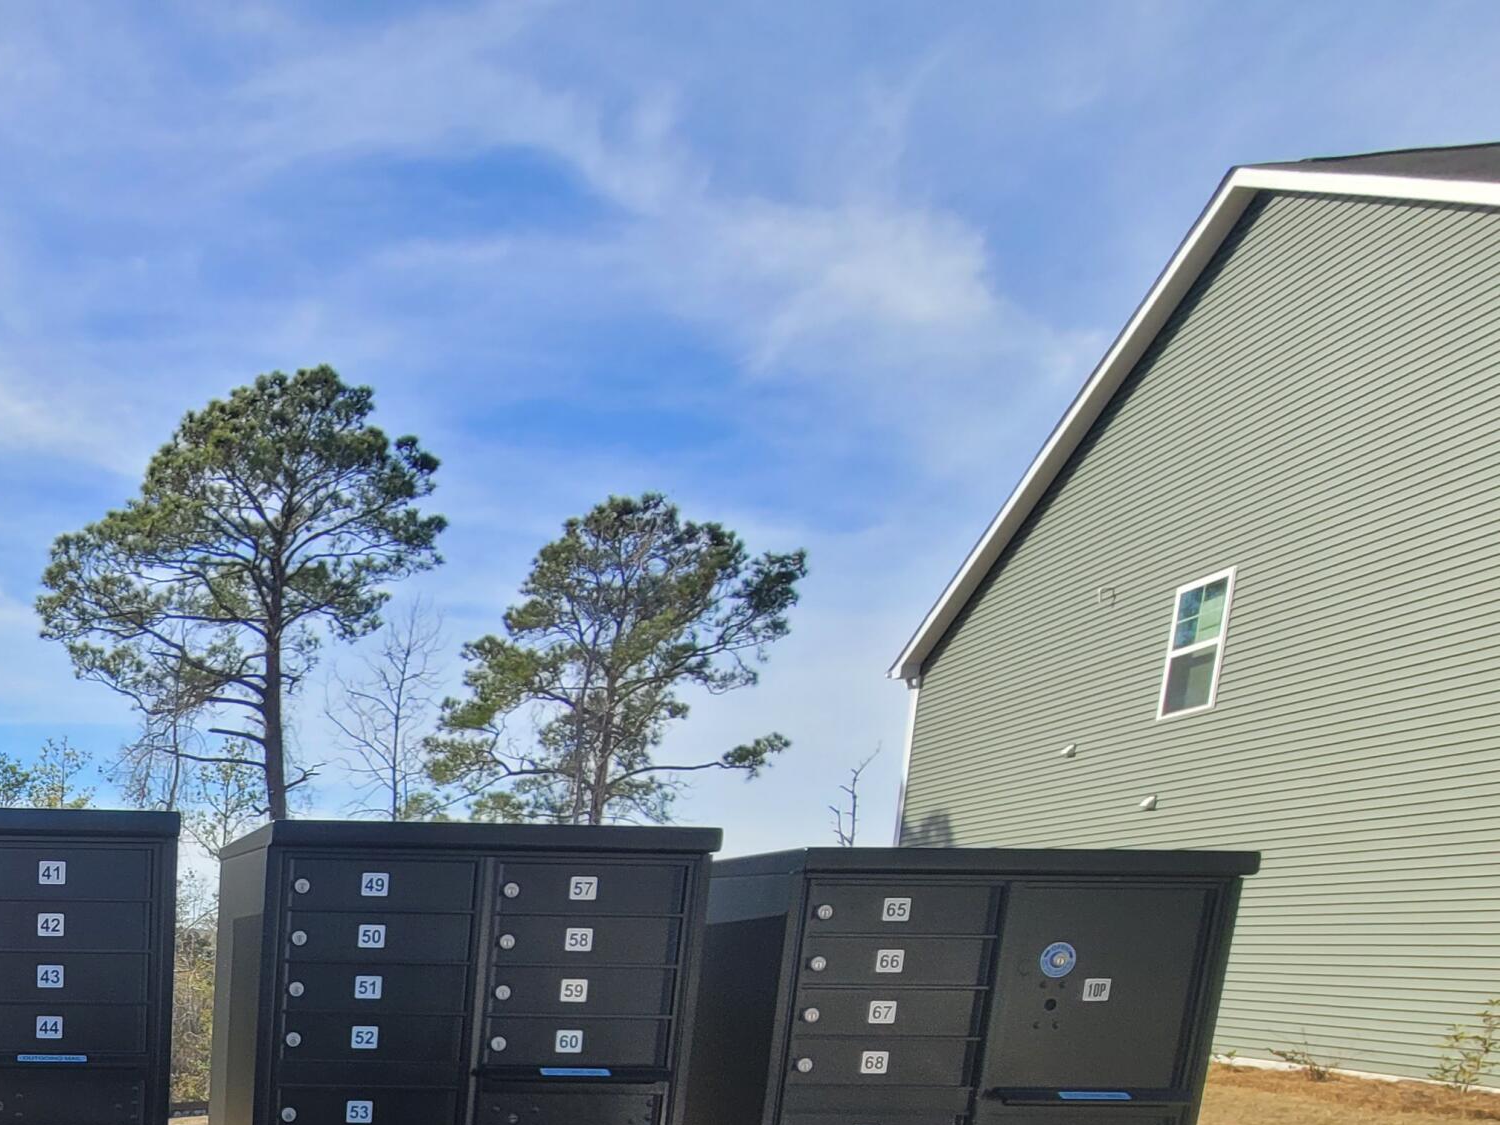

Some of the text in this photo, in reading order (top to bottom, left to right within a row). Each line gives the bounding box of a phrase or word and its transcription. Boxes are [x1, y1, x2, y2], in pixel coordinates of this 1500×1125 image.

[41, 865, 61, 881] 41
[363, 877, 385, 893] 49
[573, 881, 594, 897] 57
[885, 902, 908, 918] 65
[39, 917, 61, 933] 42
[361, 929, 382, 945] 50
[568, 932, 589, 948] 58
[879, 953, 901, 969] 66
[39, 969, 61, 985] 43
[357, 979, 377, 995] 51
[563, 983, 584, 999] 59
[1087, 982, 1107, 999] 10P
[871, 1005, 893, 1020] 67
[38, 1019, 60, 1035] 44
[354, 1030, 375, 1045] 52
[559, 1034, 579, 1049] 60
[864, 1055, 885, 1071] 68
[349, 1105, 369, 1120] 53
